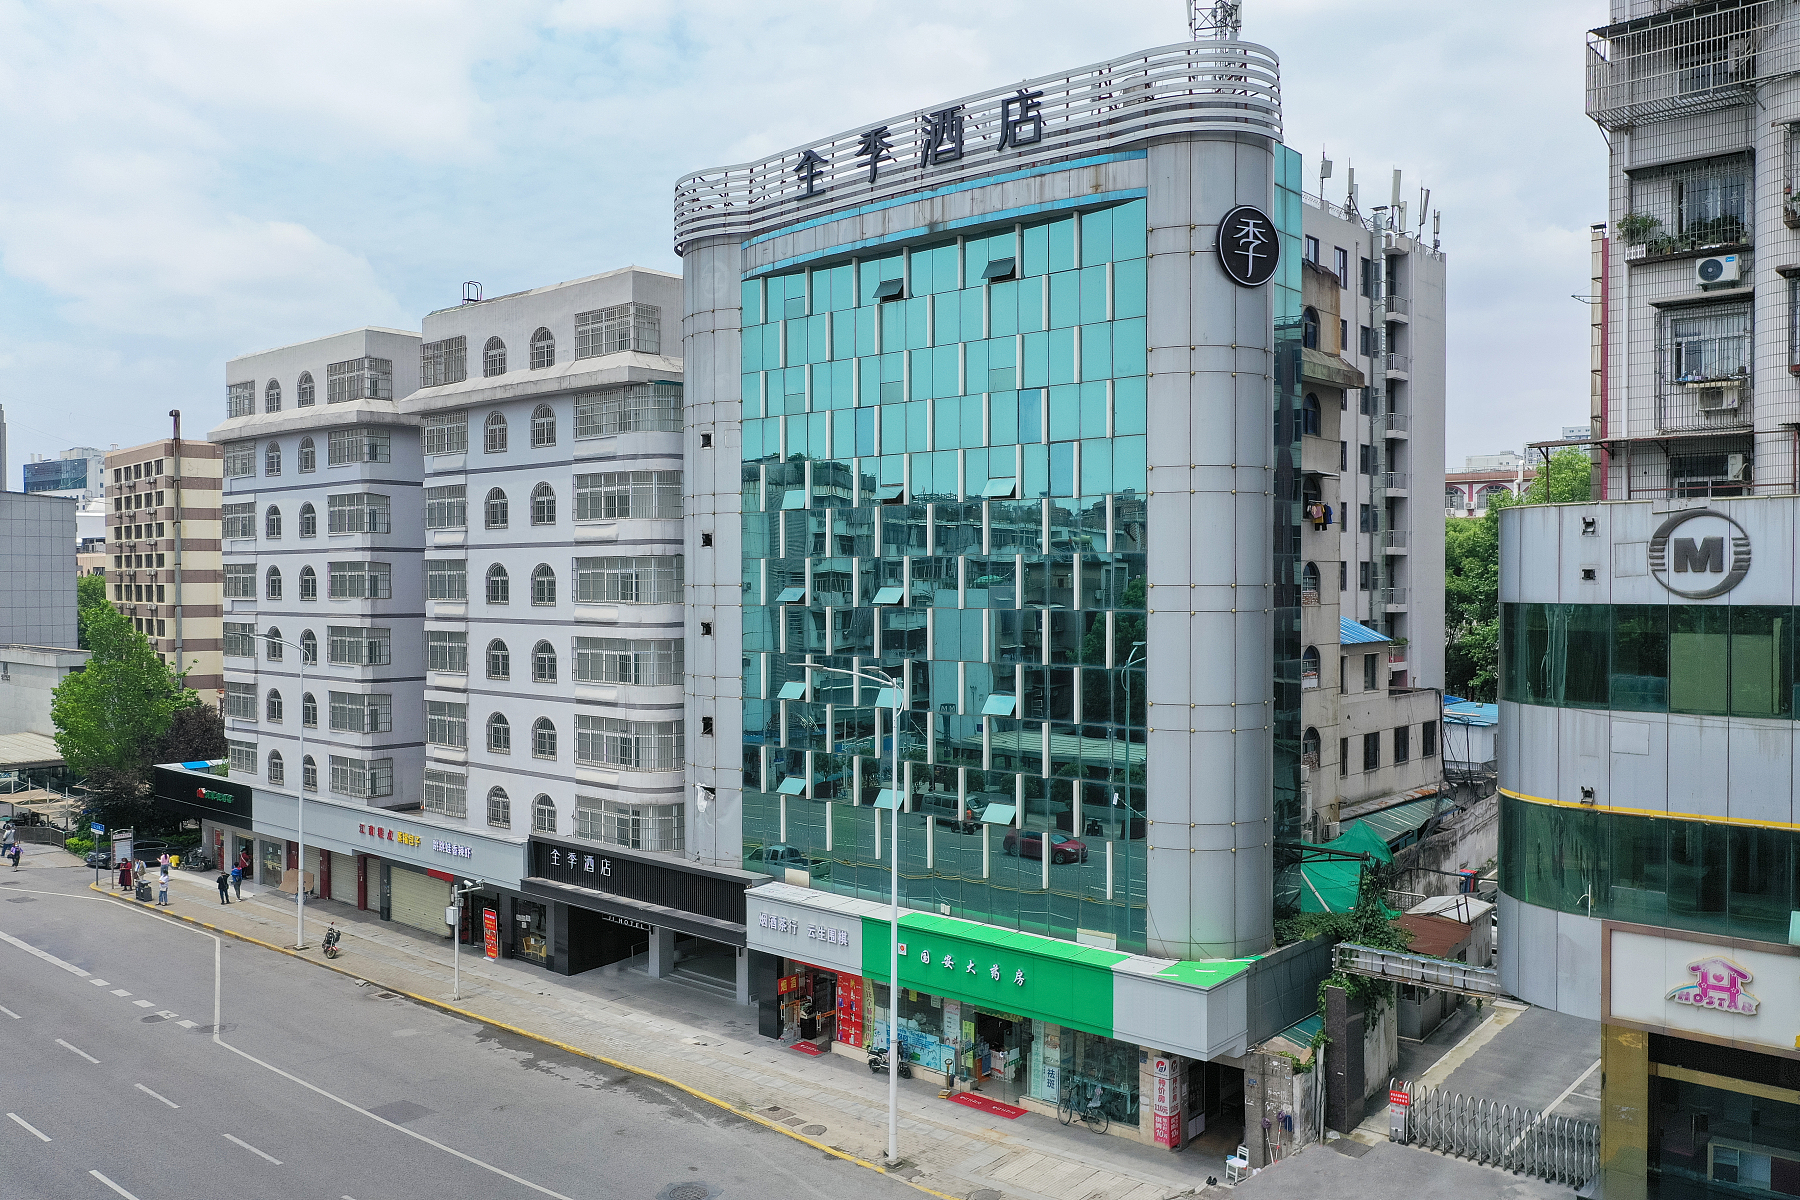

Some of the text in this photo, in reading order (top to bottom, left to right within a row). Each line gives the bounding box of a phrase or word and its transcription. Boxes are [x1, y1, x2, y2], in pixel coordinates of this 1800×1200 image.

[793, 89, 1044, 201] 全季酒店
[1233, 218, 1269, 278] 季
[550, 848, 612, 877] 全季酒店
[618, 917, 645, 930] HOTEL
[759, 912, 849, 947] 烟酒茶行 云生围棋
[920, 949, 1025, 986] 国安大药房
